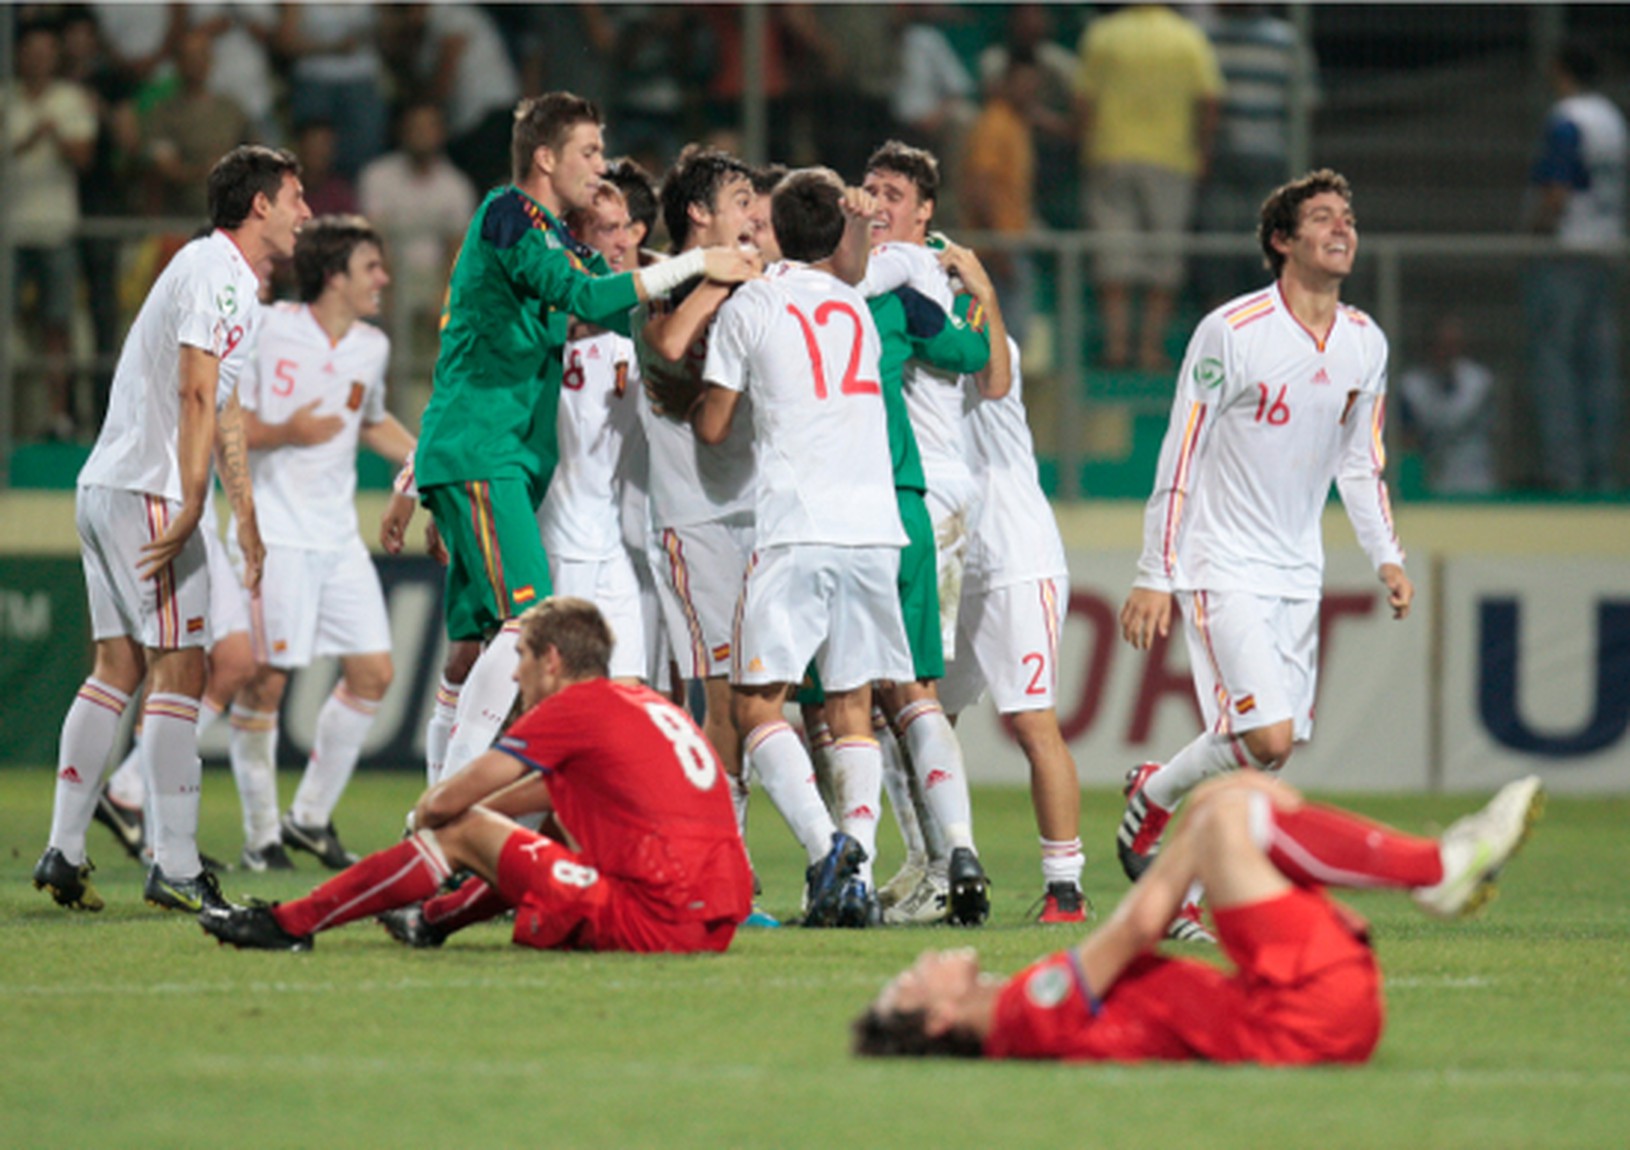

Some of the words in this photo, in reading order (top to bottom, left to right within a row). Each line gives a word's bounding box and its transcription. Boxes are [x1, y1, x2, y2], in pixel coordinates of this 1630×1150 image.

[786, 300, 882, 400] 12
[271, 358, 299, 398] 5
[1254, 381, 1291, 426] 16
[1021, 651, 1047, 695] 2
[644, 701, 717, 791] 8
[552, 859, 599, 888] 8
